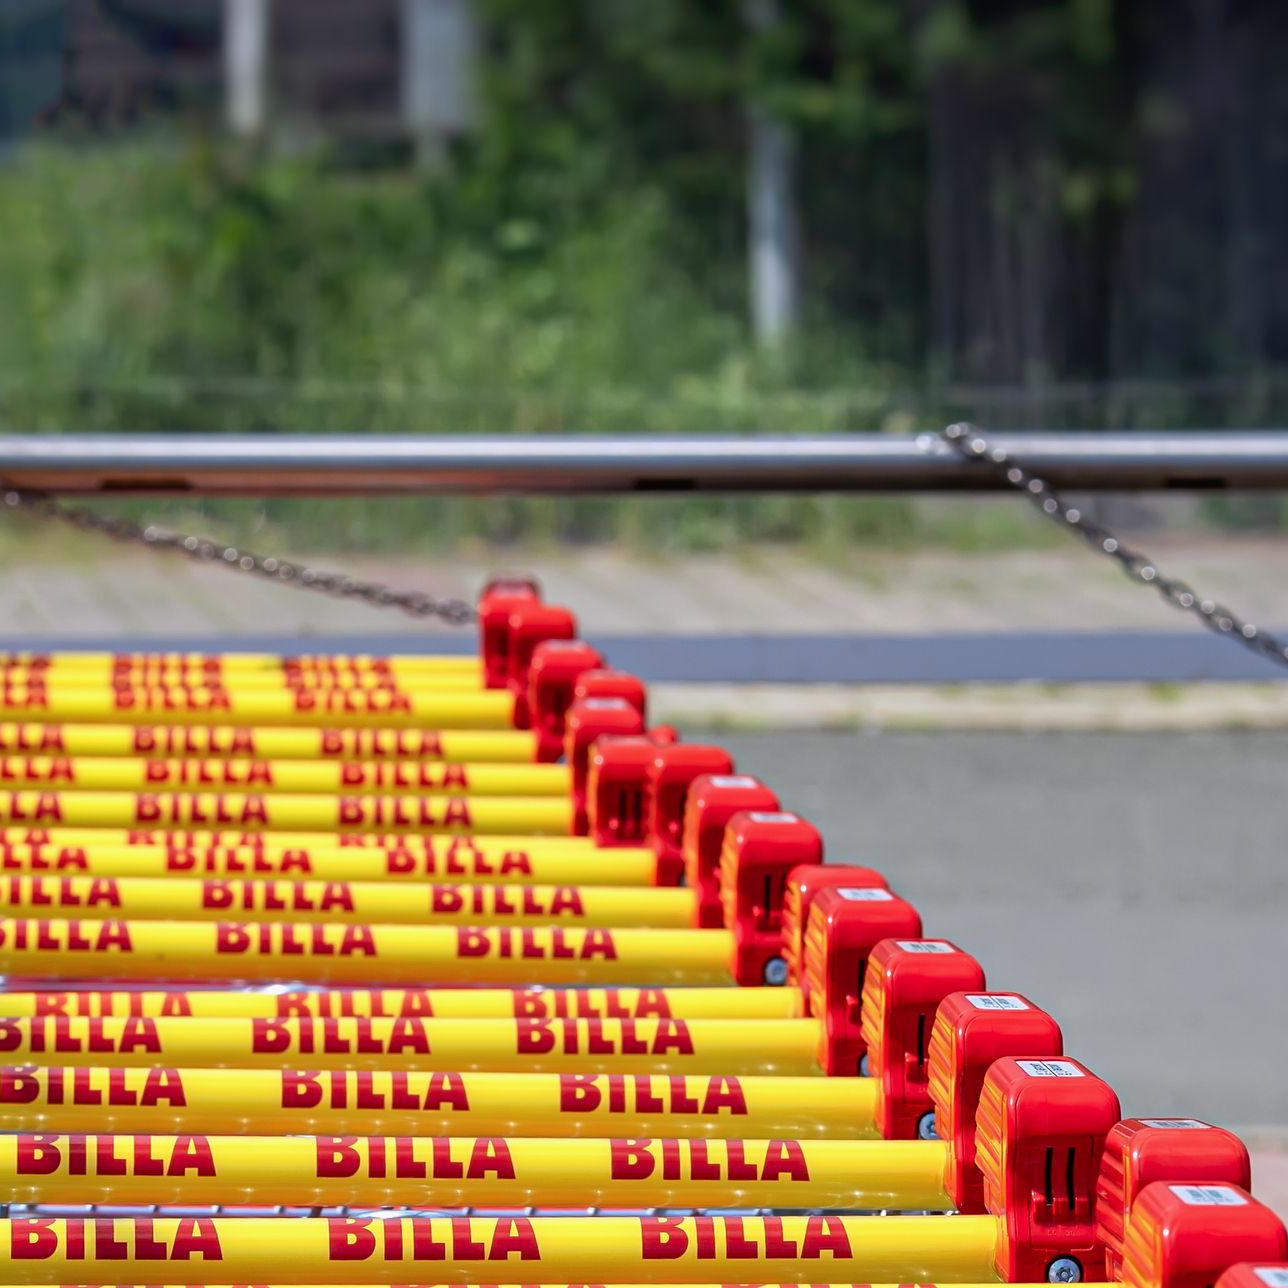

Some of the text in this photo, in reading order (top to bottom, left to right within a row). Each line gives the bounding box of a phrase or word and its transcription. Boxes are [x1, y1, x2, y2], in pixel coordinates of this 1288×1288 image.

[133, 728, 255, 755] BILLA
[321, 731, 443, 757] BILLA
[145, 760, 273, 784] BILLA
[339, 764, 468, 788] BILLA
[135, 795, 268, 826] BILLA
[337, 797, 472, 829] BILLA
[166, 848, 313, 873] BILLA
[386, 851, 533, 876] BILLA
[202, 880, 355, 912] BILLA
[431, 885, 585, 916] BILLA
[217, 923, 377, 956] BILLA
[457, 927, 617, 960] BILLA
[252, 1018, 431, 1054] BILLA
[516, 1018, 695, 1055] BILLA
[281, 1071, 470, 1110] BILLA
[560, 1074, 748, 1115] BILLA
[16, 1135, 810, 1182] BILLA BILLA BILLA
[10, 1217, 853, 1261] BILLA BILLA BILLA
